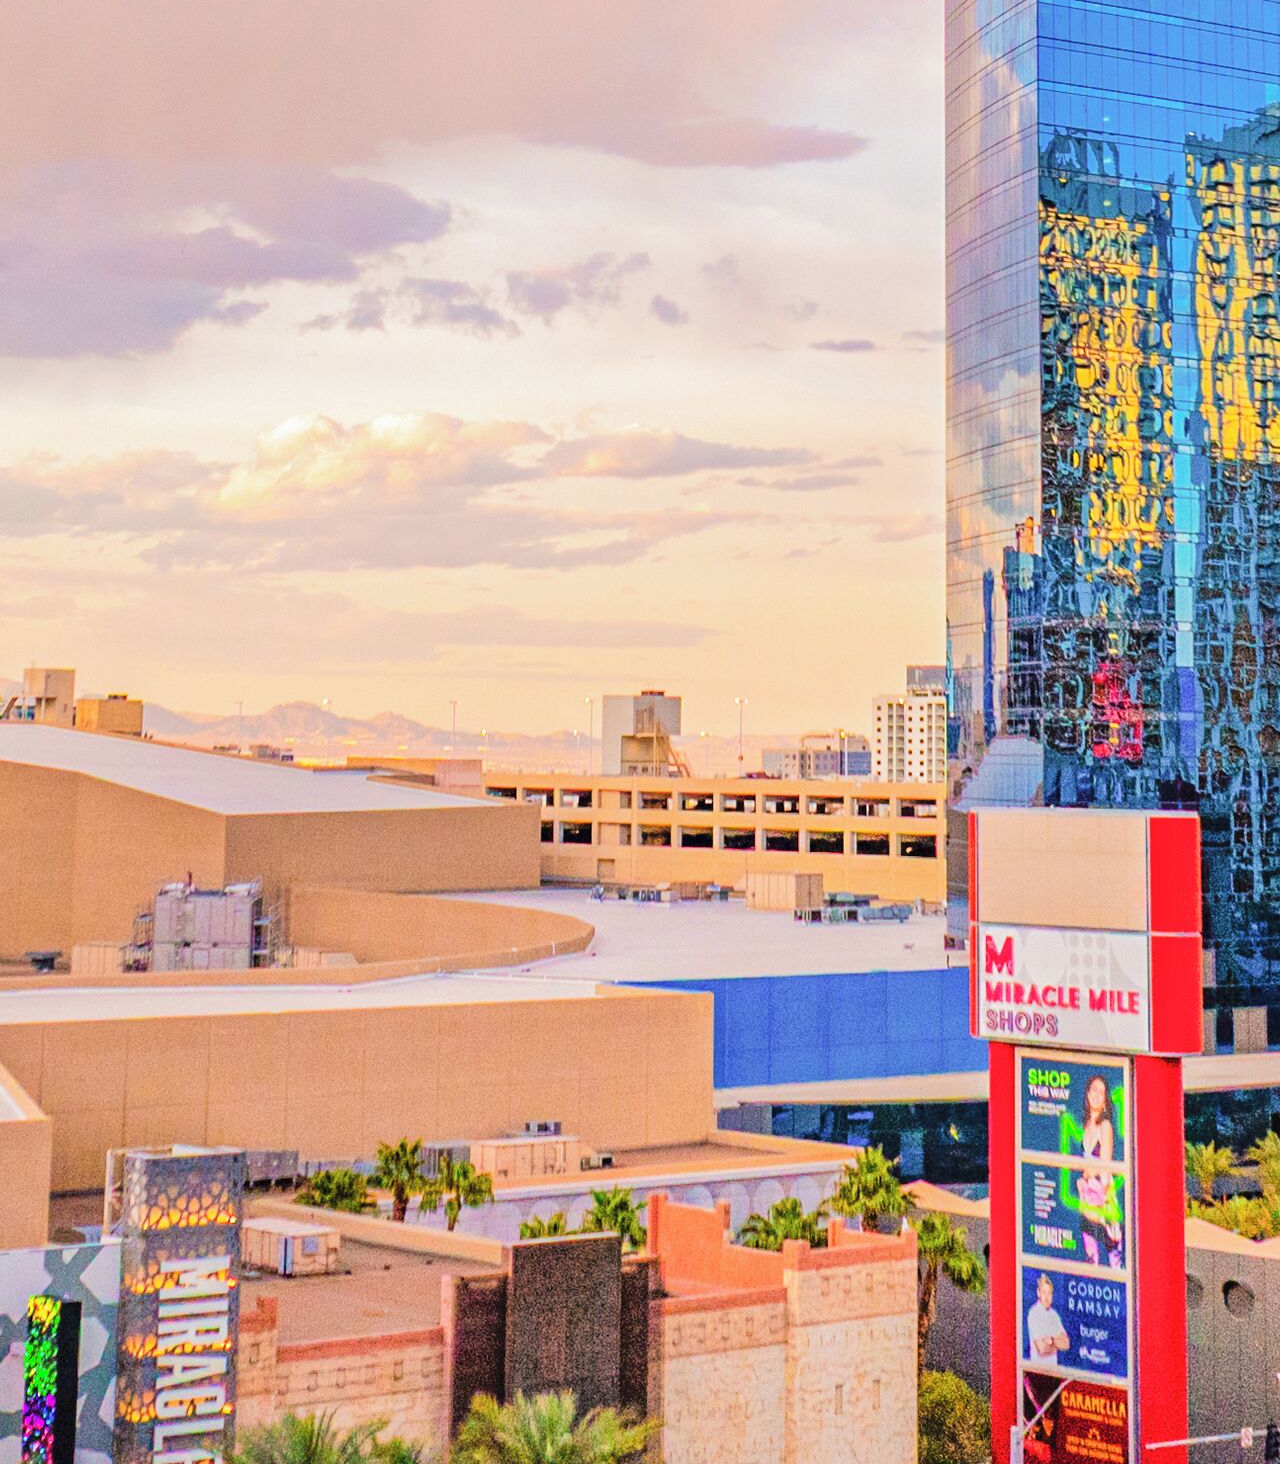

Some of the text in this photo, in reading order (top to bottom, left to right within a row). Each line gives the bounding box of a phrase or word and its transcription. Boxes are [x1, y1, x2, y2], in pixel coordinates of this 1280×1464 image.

[985, 934, 1014, 975] M
[985, 980, 1140, 1015] MIRACLE MILE
[986, 1008, 1058, 1037] SHOPS
[1028, 1068, 1071, 1088] SHOP
[1068, 1280, 1120, 1303] GORDON
[1068, 1297, 1120, 1319] RAMSAY
[1080, 1323, 1109, 1343] burger
[1061, 1390, 1126, 1418] CARAMELLA
